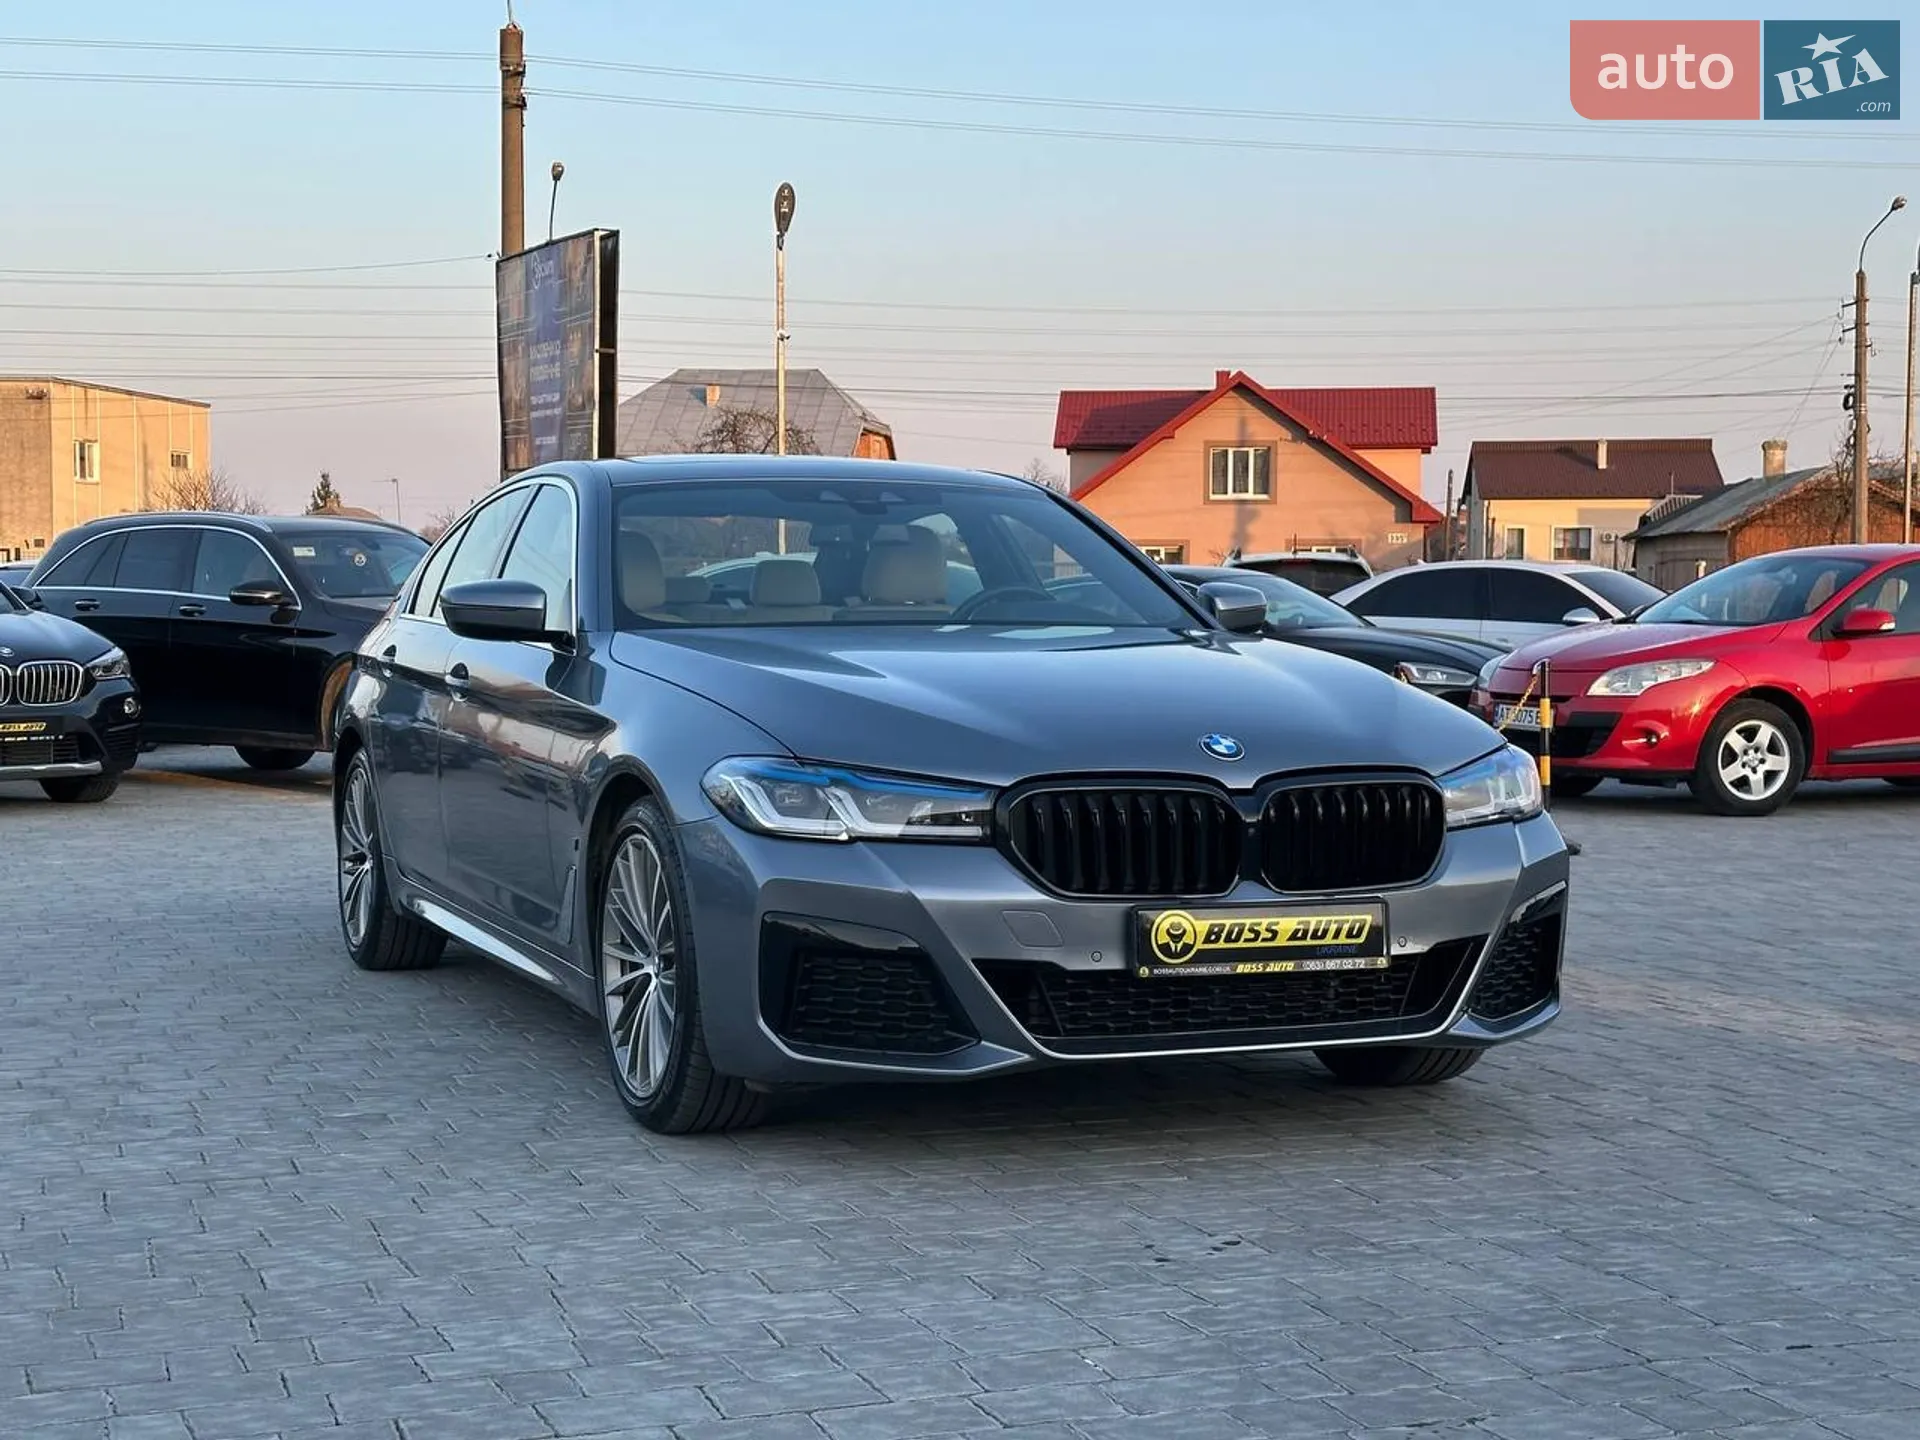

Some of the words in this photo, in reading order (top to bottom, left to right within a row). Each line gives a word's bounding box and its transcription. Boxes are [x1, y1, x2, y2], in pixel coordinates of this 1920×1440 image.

[1202, 920, 1281, 945] BOSS
[1287, 917, 1368, 942] AUTO
[1236, 963, 1264, 973] BOSS
[1265, 962, 1295, 972] AUTO
